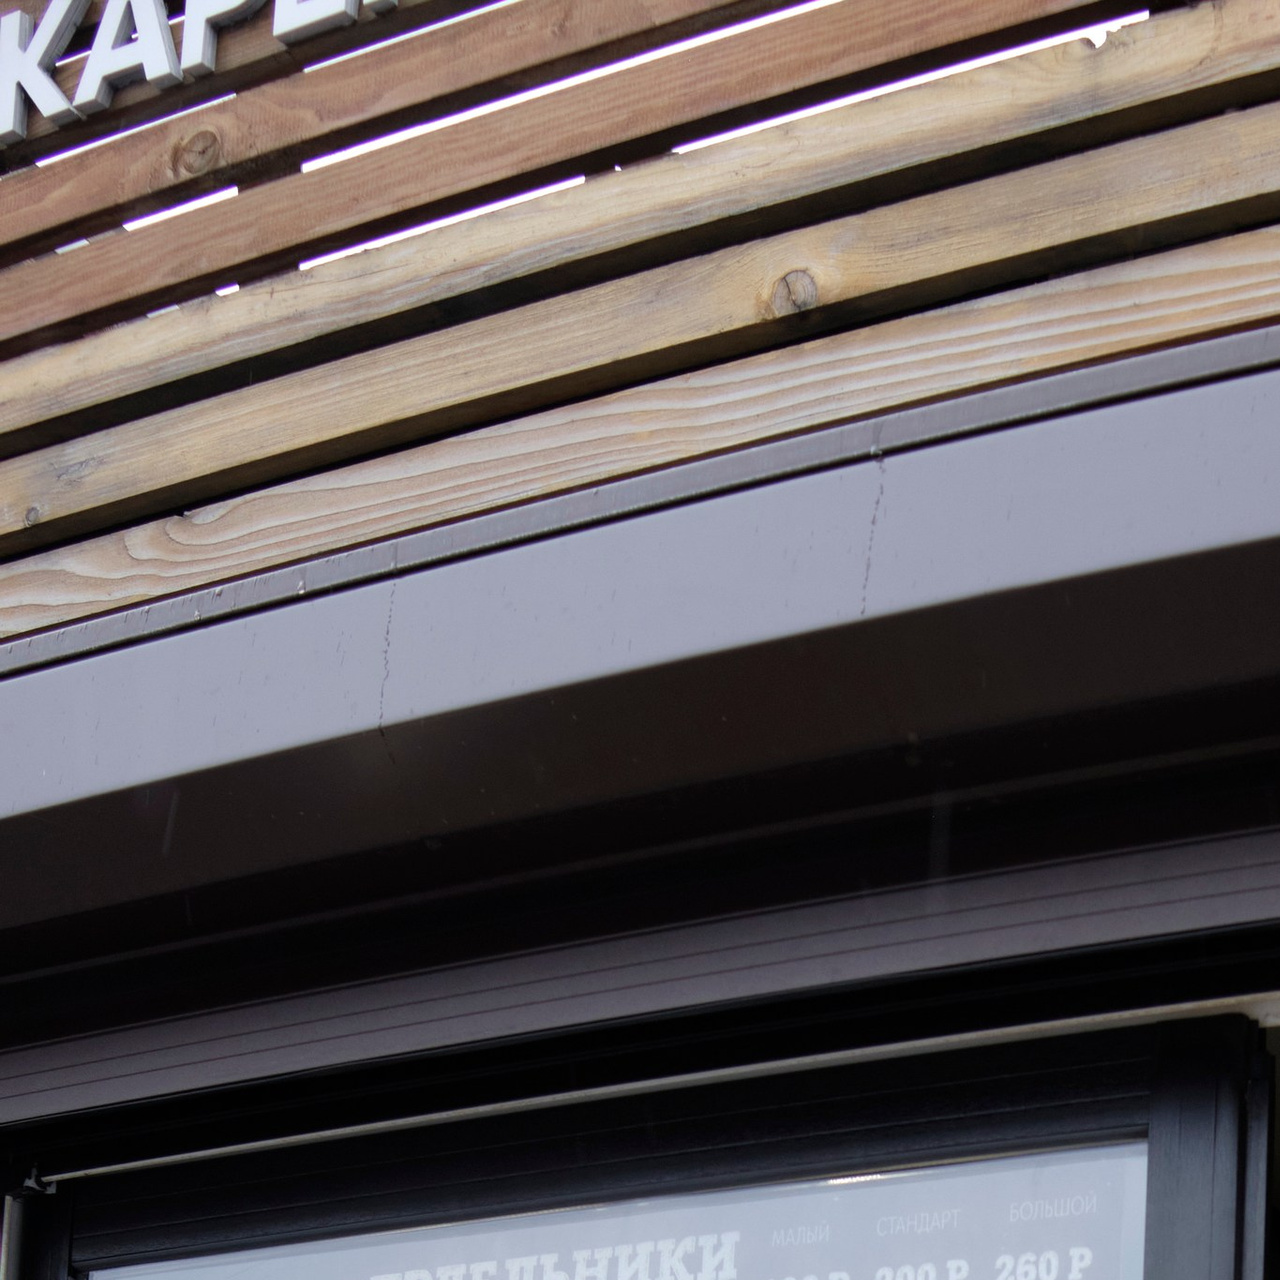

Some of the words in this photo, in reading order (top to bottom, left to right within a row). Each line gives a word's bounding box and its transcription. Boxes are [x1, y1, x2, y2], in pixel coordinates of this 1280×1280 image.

[772, 1224, 830, 1248] МАЛЫЙ
[876, 1209, 961, 1236] СТАНДАРТ
[1010, 1196, 1098, 1222] БОЛЬШОЙ
